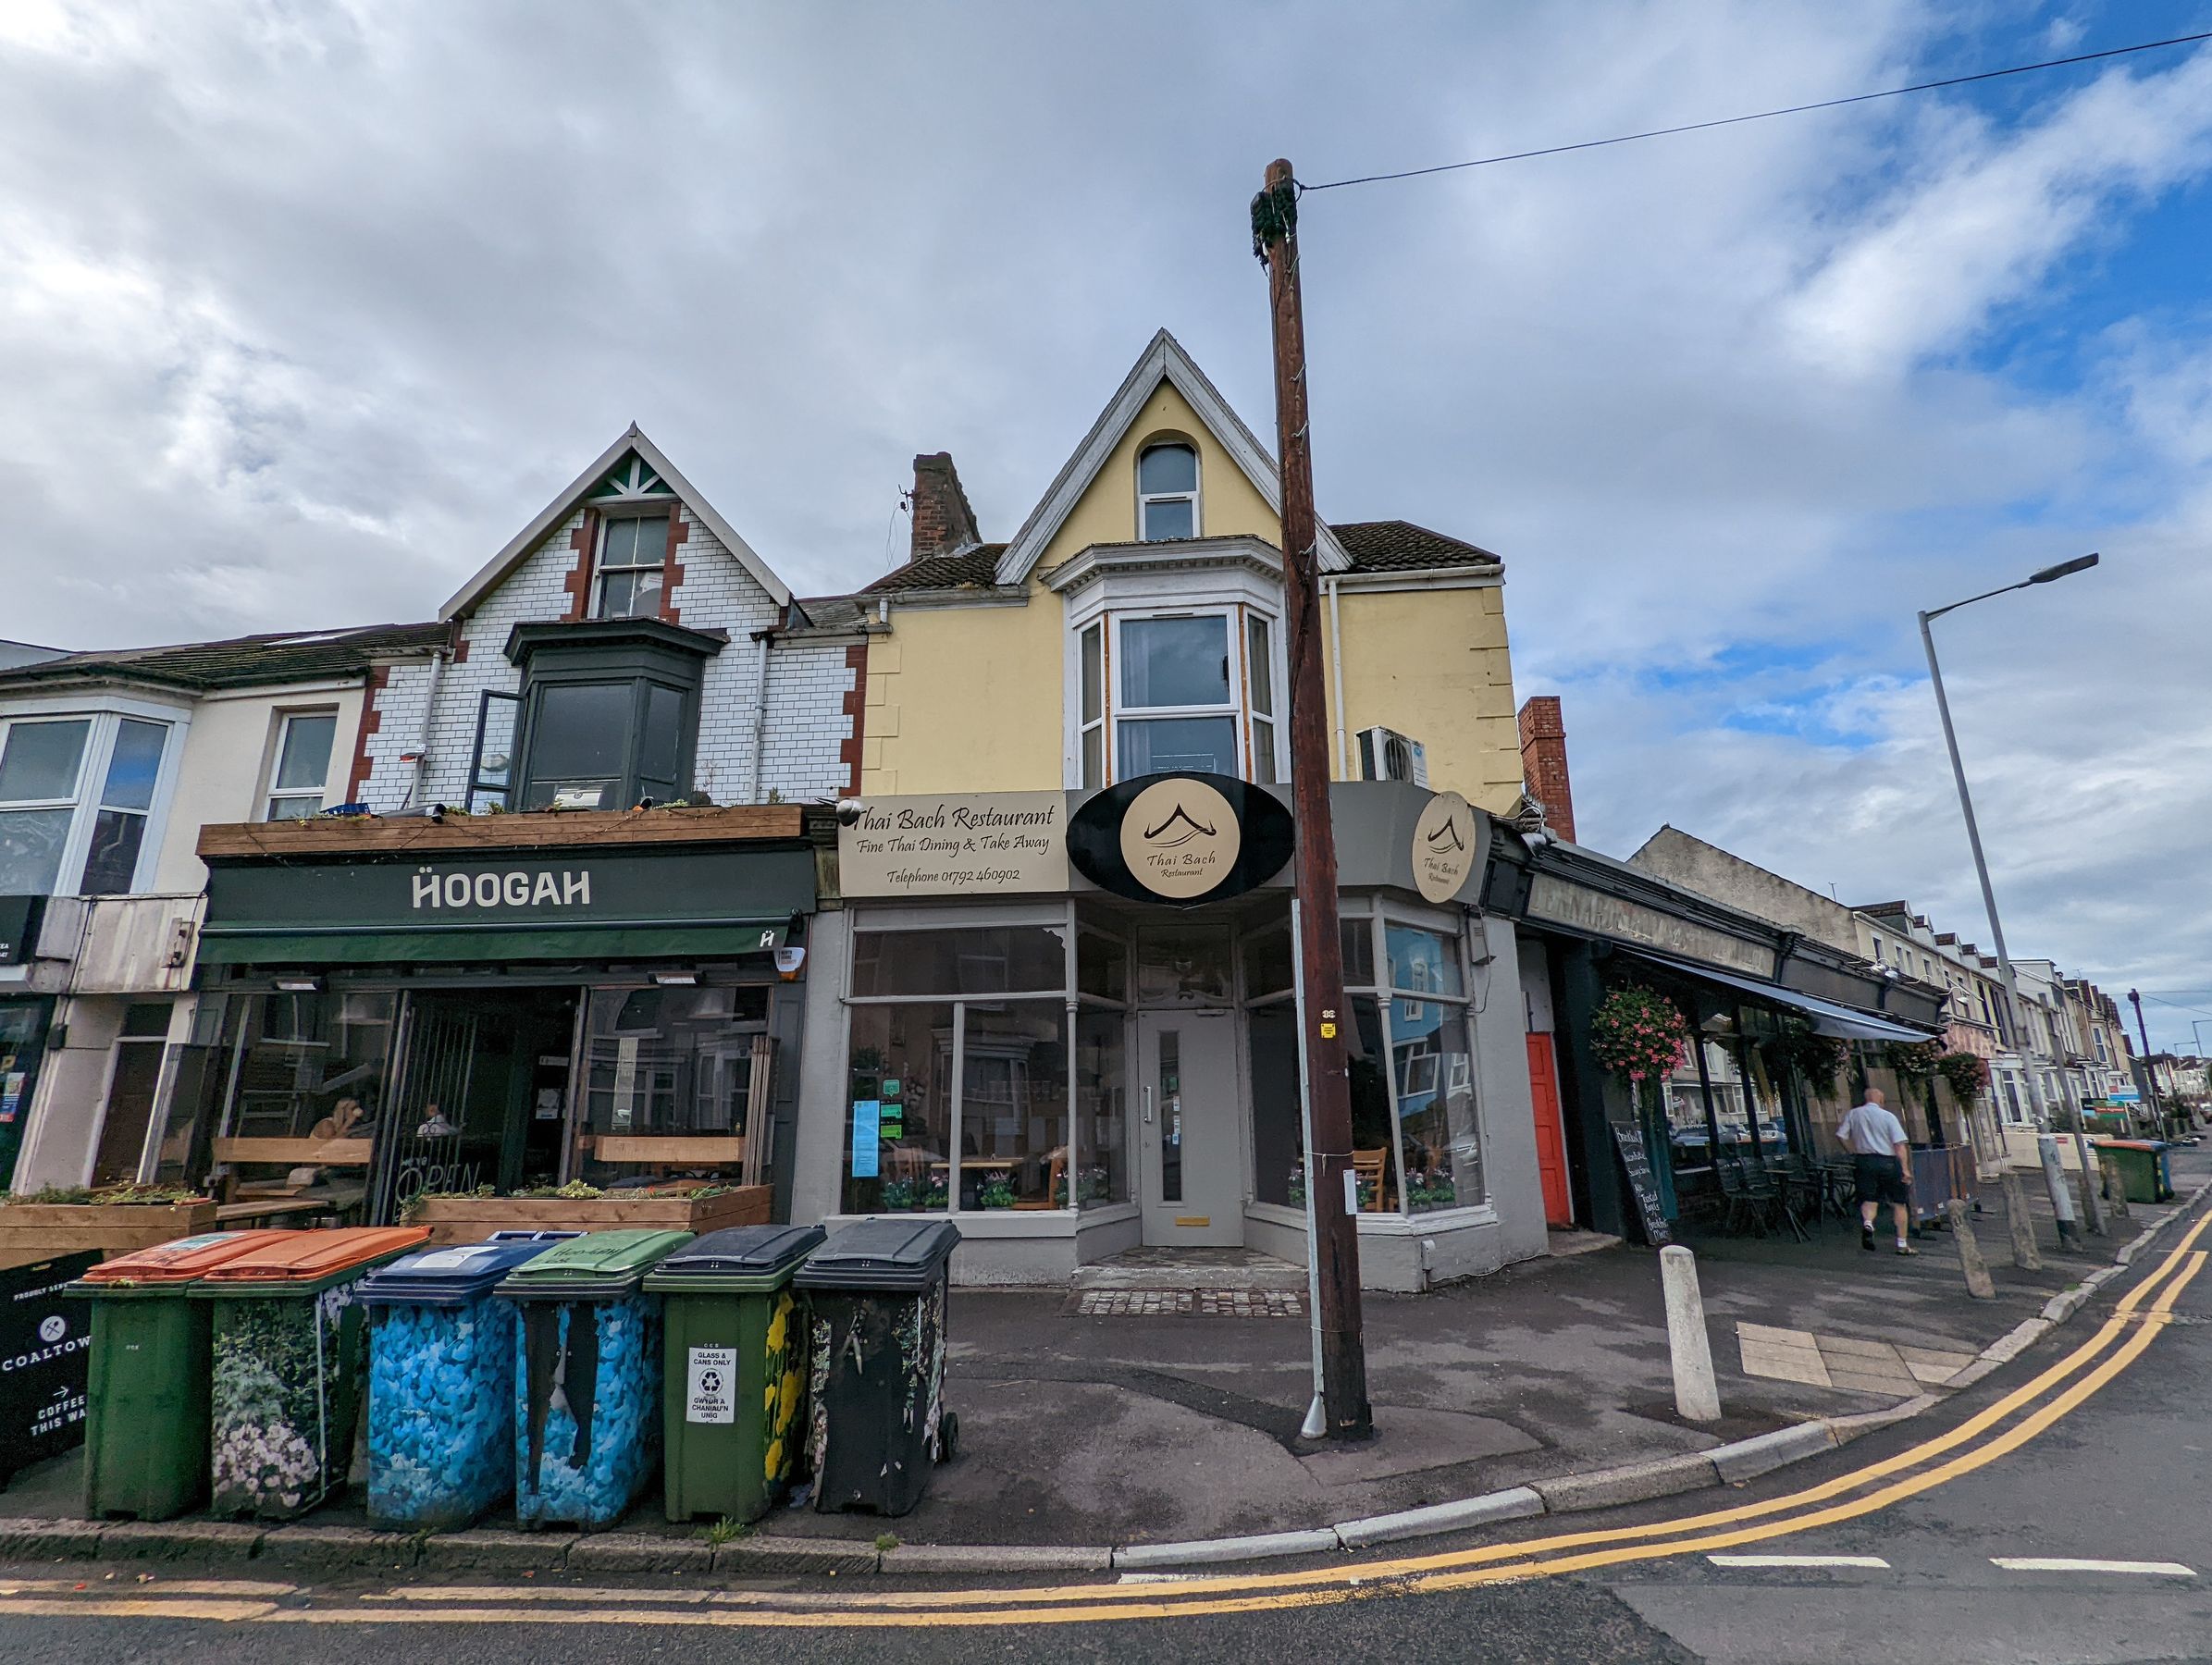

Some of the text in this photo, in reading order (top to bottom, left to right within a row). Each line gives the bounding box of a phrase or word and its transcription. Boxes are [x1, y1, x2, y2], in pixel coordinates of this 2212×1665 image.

[896, 804, 945, 830] Bach
[952, 805, 1055, 830] Restaurant
[857, 832, 1050, 857] Fine Thai Dining & Take Away
[1147, 851, 1216, 866] Thai Bach
[1424, 857, 1440, 870] Thai
[887, 867, 1020, 888] Telephone 01792 460902
[1160, 868, 1203, 878] Restaurant
[48, 1282, 68, 1292] SERV
[2, 1335, 93, 1371] COALTOW
[693, 1358, 711, 1366] CANS
[38, 1395, 86, 1420] COFFEE
[693, 1397, 719, 1405] GWYDR
[30, 1409, 87, 1437] THIS WA
